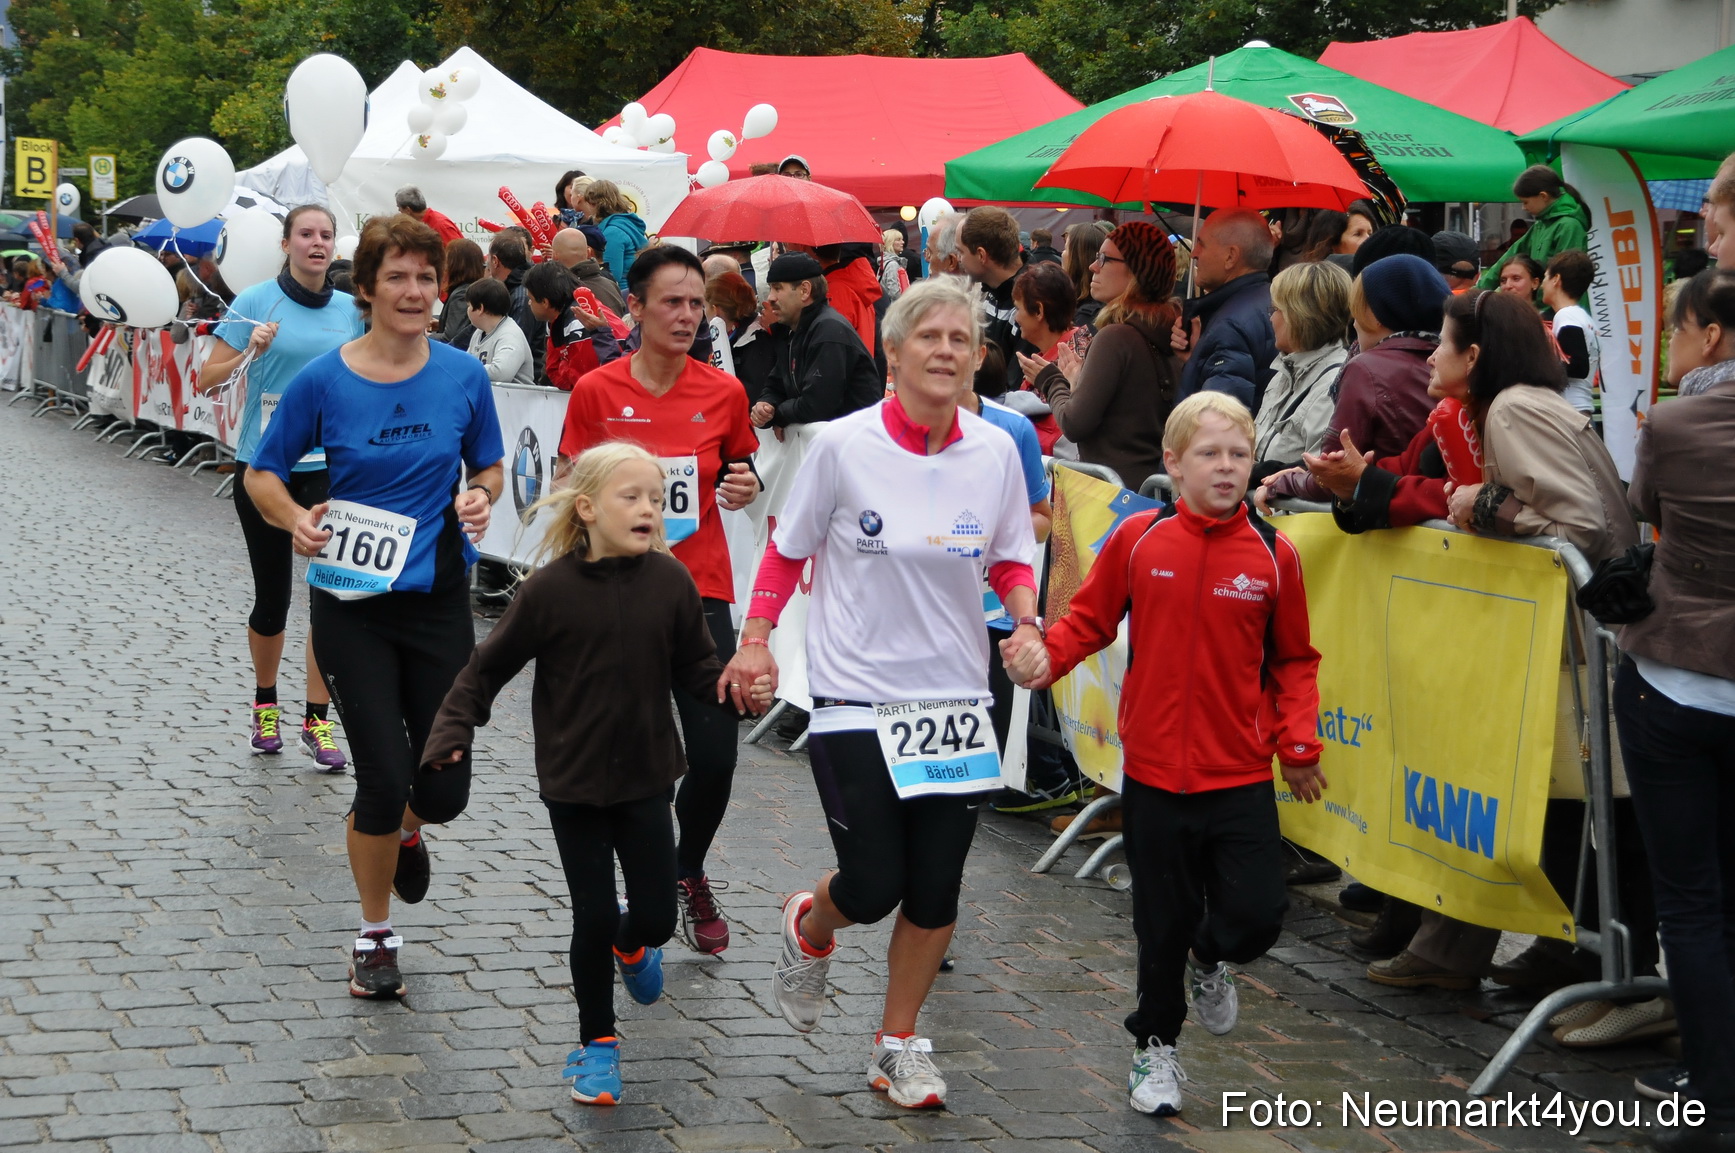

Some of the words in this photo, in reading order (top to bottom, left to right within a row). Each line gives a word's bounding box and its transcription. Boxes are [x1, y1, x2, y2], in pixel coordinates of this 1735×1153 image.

[21, 140, 53, 153] Block
[1360, 130, 1413, 143] arkter
[27, 156, 46, 184] B
[169, 157, 195, 175] BMW
[379, 423, 432, 439] ERTEL
[380, 432, 433, 443] AUTOMOBILE
[515, 429, 540, 463] BMW
[662, 480, 689, 514] 6
[324, 509, 342, 520] ARTL
[344, 512, 394, 532] Neumarkt
[316, 523, 398, 572] 2160
[856, 538, 888, 549] PARTL
[856, 546, 888, 556] Neumarkt
[313, 568, 379, 589] Heidemarie
[876, 703, 916, 717] PARTL
[918, 699, 967, 711] Neumarkt
[890, 712, 986, 758] 2242
[1104, 728, 1122, 750] Auße
[925, 761, 970, 780] Bärbel
[1403, 764, 1499, 860] KANN
